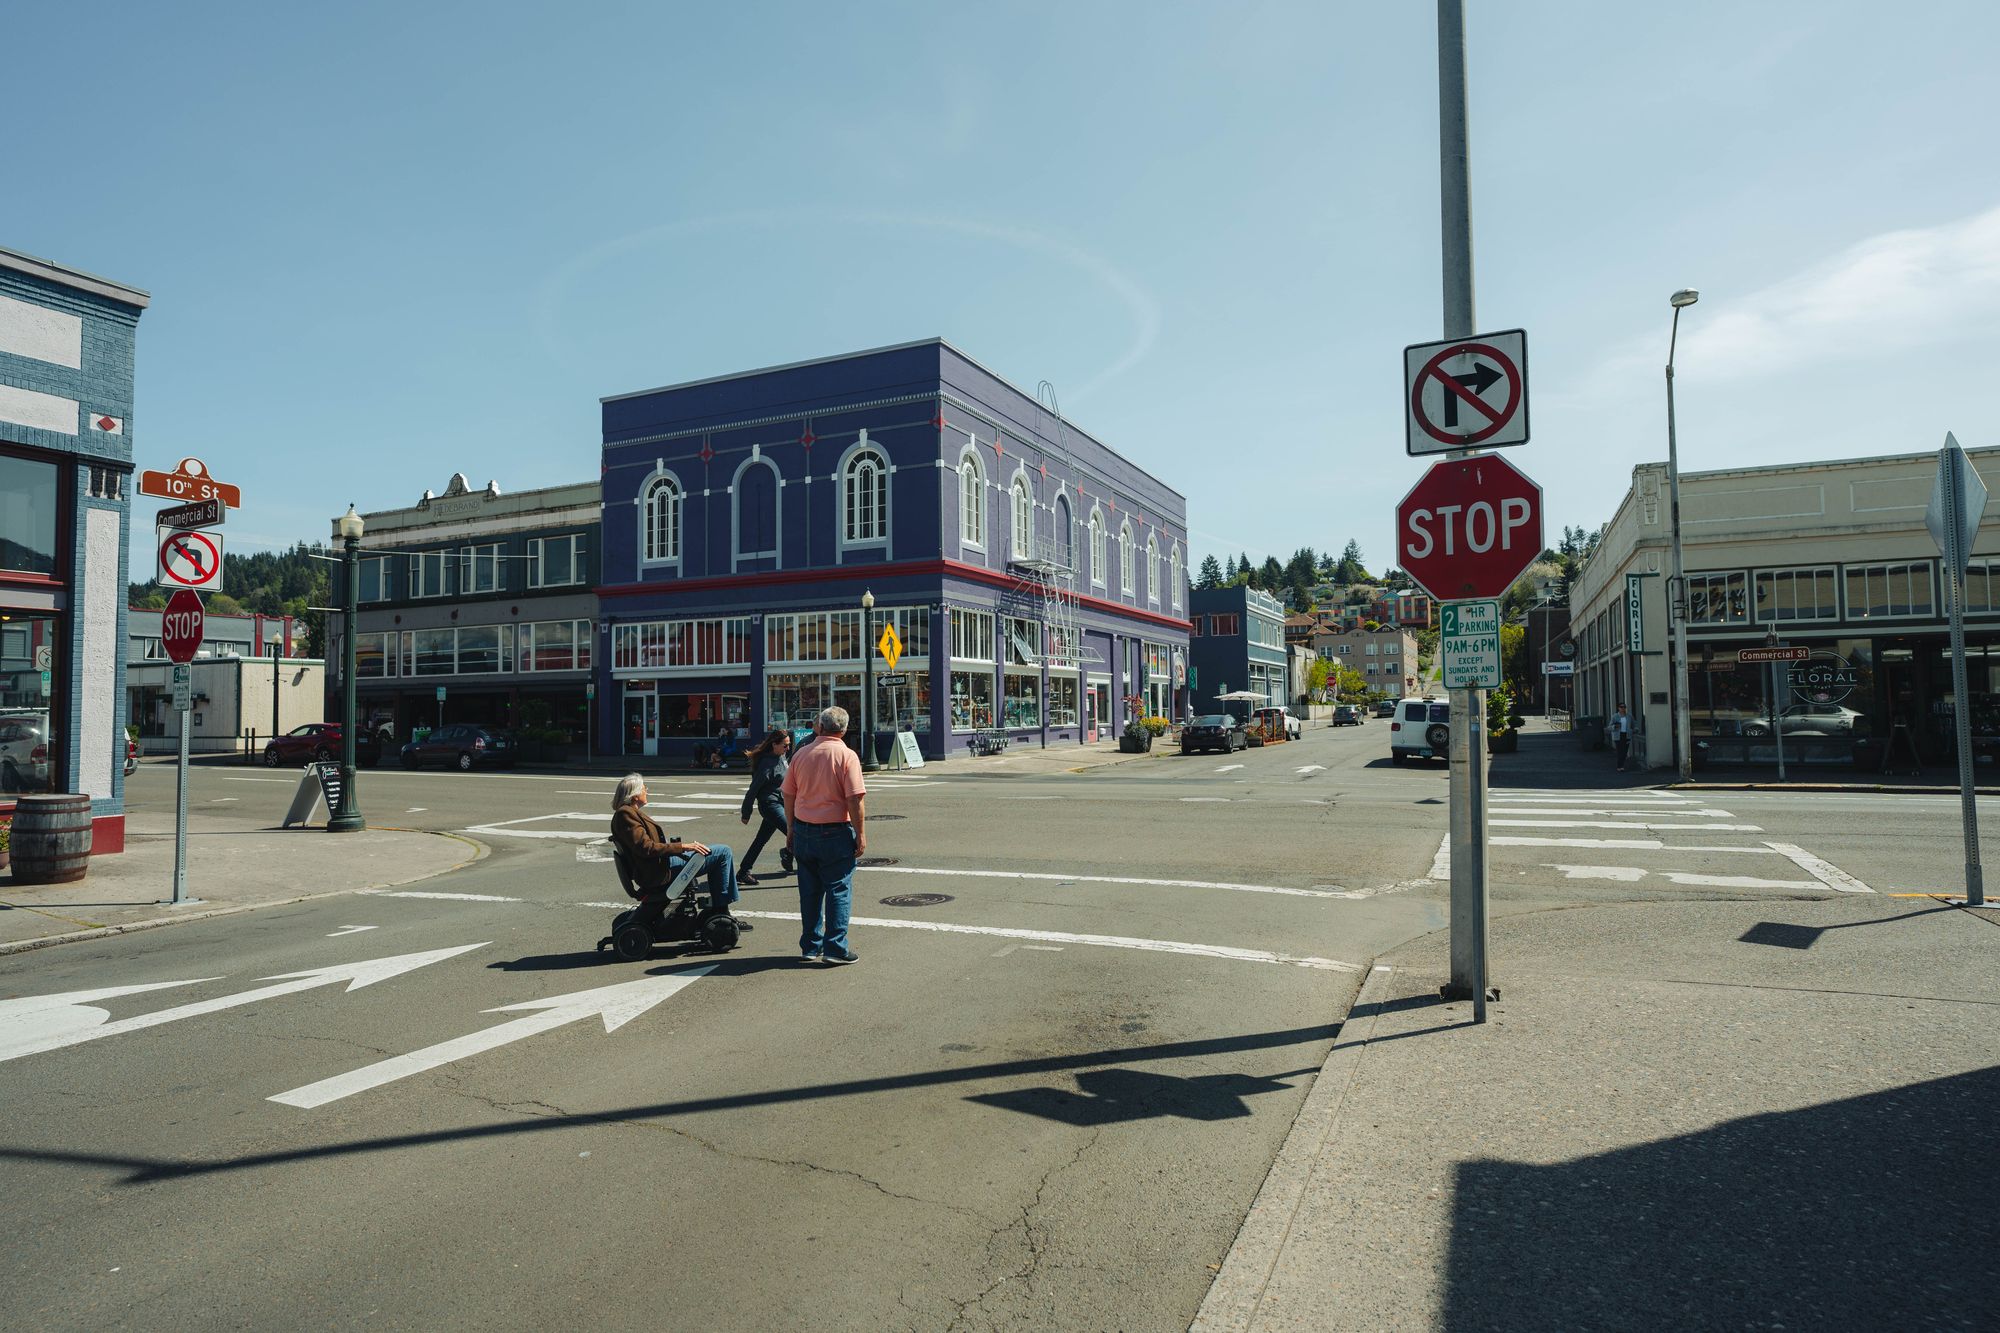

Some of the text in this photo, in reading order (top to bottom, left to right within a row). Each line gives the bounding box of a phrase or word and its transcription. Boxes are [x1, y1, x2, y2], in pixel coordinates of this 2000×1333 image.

[165, 479, 219, 500] 10th St
[158, 504, 216, 527] Commercial St
[1407, 497, 1531, 559] STOP
[1470, 606, 1486, 618] HR
[1631, 579, 1641, 650] FLORIST
[164, 611, 201, 641] STOP
[1445, 611, 1455, 632] 2
[1459, 620, 1496, 633] PARKING
[1458, 656, 1483, 665] EXCEPT
[1741, 649, 1807, 661] Commercial St
[1448, 665, 1495, 674] SUNDAYS AND
[1455, 675, 1489, 684] HOLIDAYS
[1787, 672, 1857, 684] FLORAL
